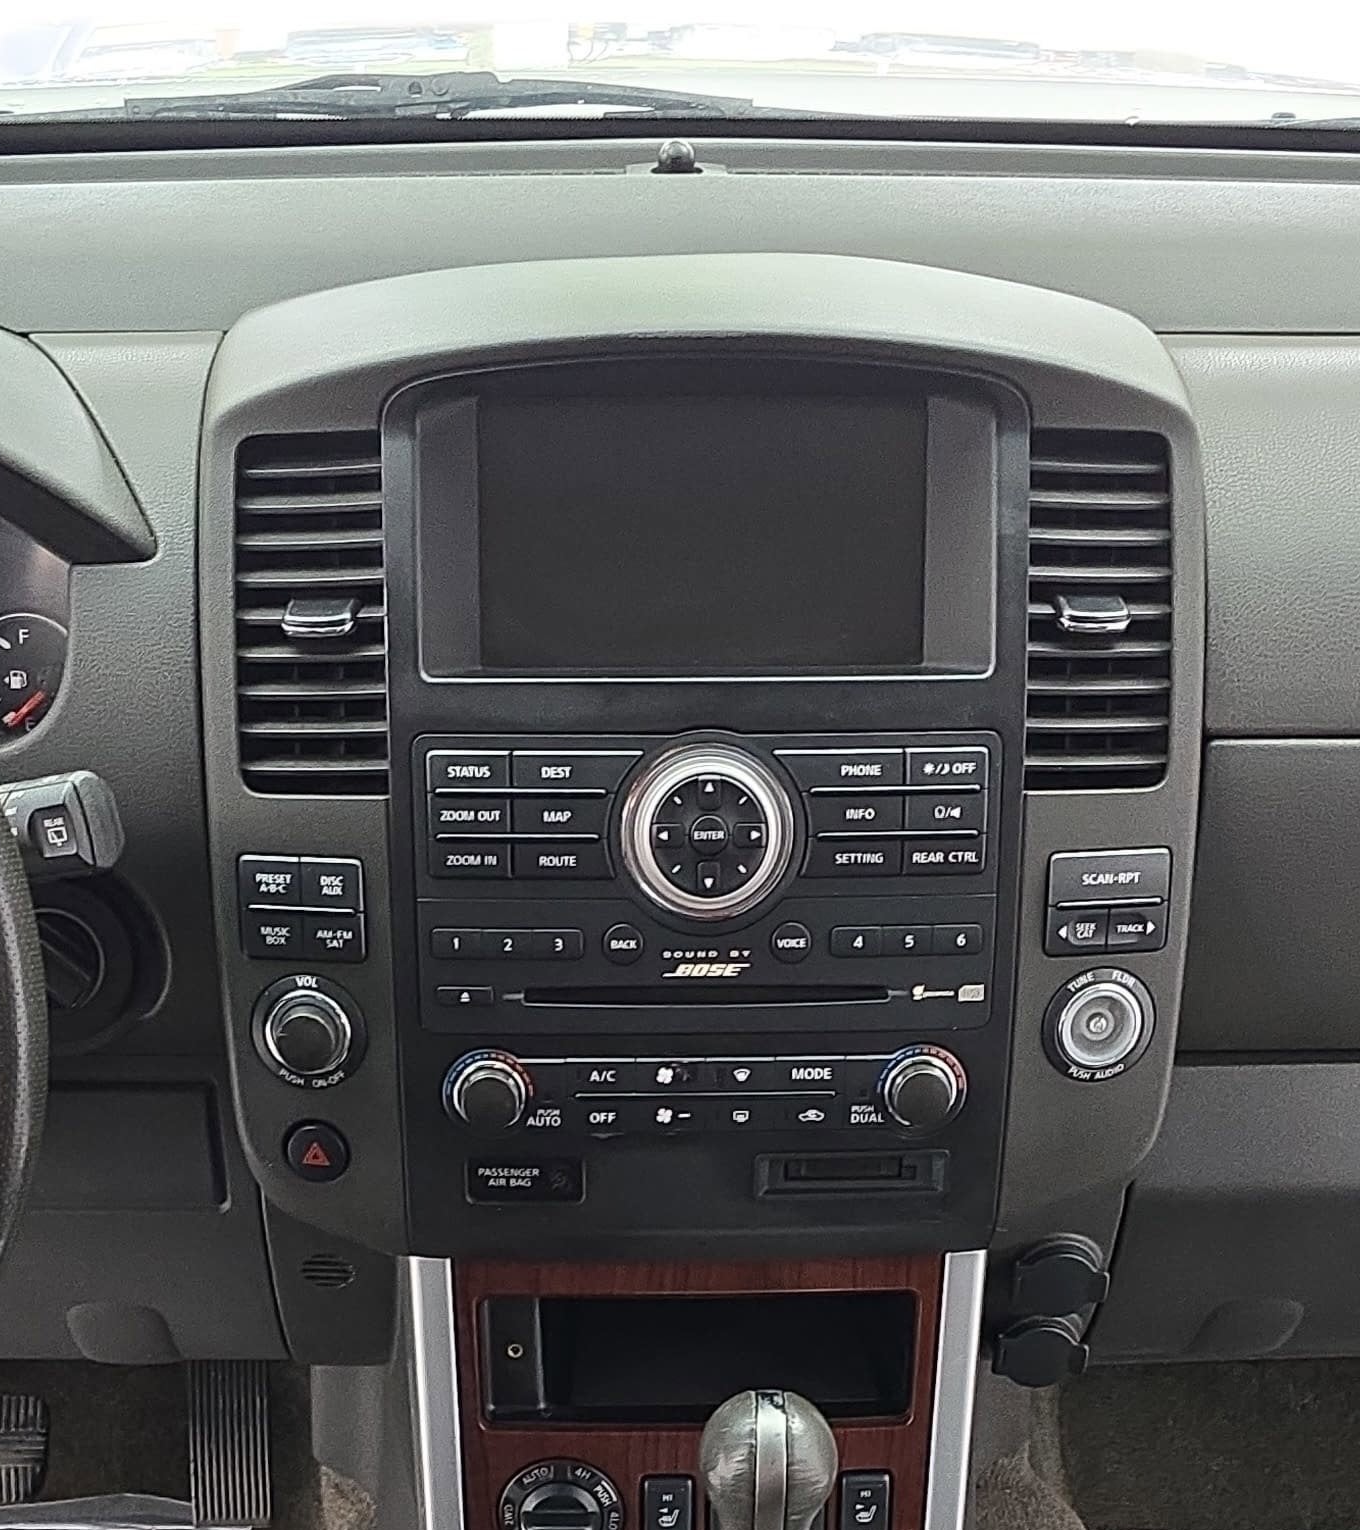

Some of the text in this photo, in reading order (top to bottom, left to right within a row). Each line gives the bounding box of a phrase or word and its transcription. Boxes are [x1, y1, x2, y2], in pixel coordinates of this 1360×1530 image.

[19, 629, 29, 644] F
[447, 766, 491, 778] STATUS
[541, 766, 572, 778] DEST
[840, 764, 882, 776] PHONE
[952, 762, 977, 774] OFF
[440, 810, 501, 822] ZOOM OUT
[543, 811, 572, 823] MAP
[845, 808, 875, 820] INFO
[693, 830, 725, 841] ENTER
[446, 855, 497, 866] ZOOM IN
[539, 856, 577, 867] ROUTE
[835, 853, 884, 865] SETTING
[912, 851, 979, 864] REAR CTRL
[255, 873, 291, 884] PRESET
[320, 876, 344, 886] DISC
[321, 886, 343, 895] AUX
[260, 926, 290, 937] MUSIC
[1075, 922, 1096, 931] SEEK
[1116, 923, 1144, 934] TRACK
[266, 936, 286, 945] BOX
[956, 934, 966, 947] 6
[1077, 930, 1094, 939] CAT
[326, 940, 344, 949] SAT
[453, 937, 460, 949] 1
[503, 938, 512, 951] 2
[554, 938, 563, 951] 3
[610, 939, 637, 949] BACK
[777, 938, 807, 949] VOICE
[853, 935, 863, 948] 4
[904, 935, 915, 948] 5
[662, 950, 718, 959] SOUND
[662, 963, 751, 977] BOSE
[295, 976, 318, 988] VOL
[1067, 972, 1096, 993] TUNE
[279, 1069, 304, 1086] PUSH
[590, 1070, 616, 1082] A/C
[791, 1067, 832, 1080] MODE
[1068, 1063, 1125, 1080] PUSH AUDIO
[850, 1105, 875, 1113] PUSH
[526, 1116, 562, 1127] AUTO
[589, 1112, 616, 1124] OFF
[850, 1112, 885, 1124] DUAL
[478, 1167, 539, 1177] PASSENGER
[488, 1178, 532, 1187] AIR BAG
[522, 1467, 549, 1485] AUTO
[575, 1467, 592, 1480] 4H
[593, 1484, 613, 1507] PUSH
[662, 1494, 673, 1502] HI
[860, 1490, 872, 1498] HI
[504, 1504, 514, 1526] 2WD
[608, 1511, 620, 1530] 4LO
